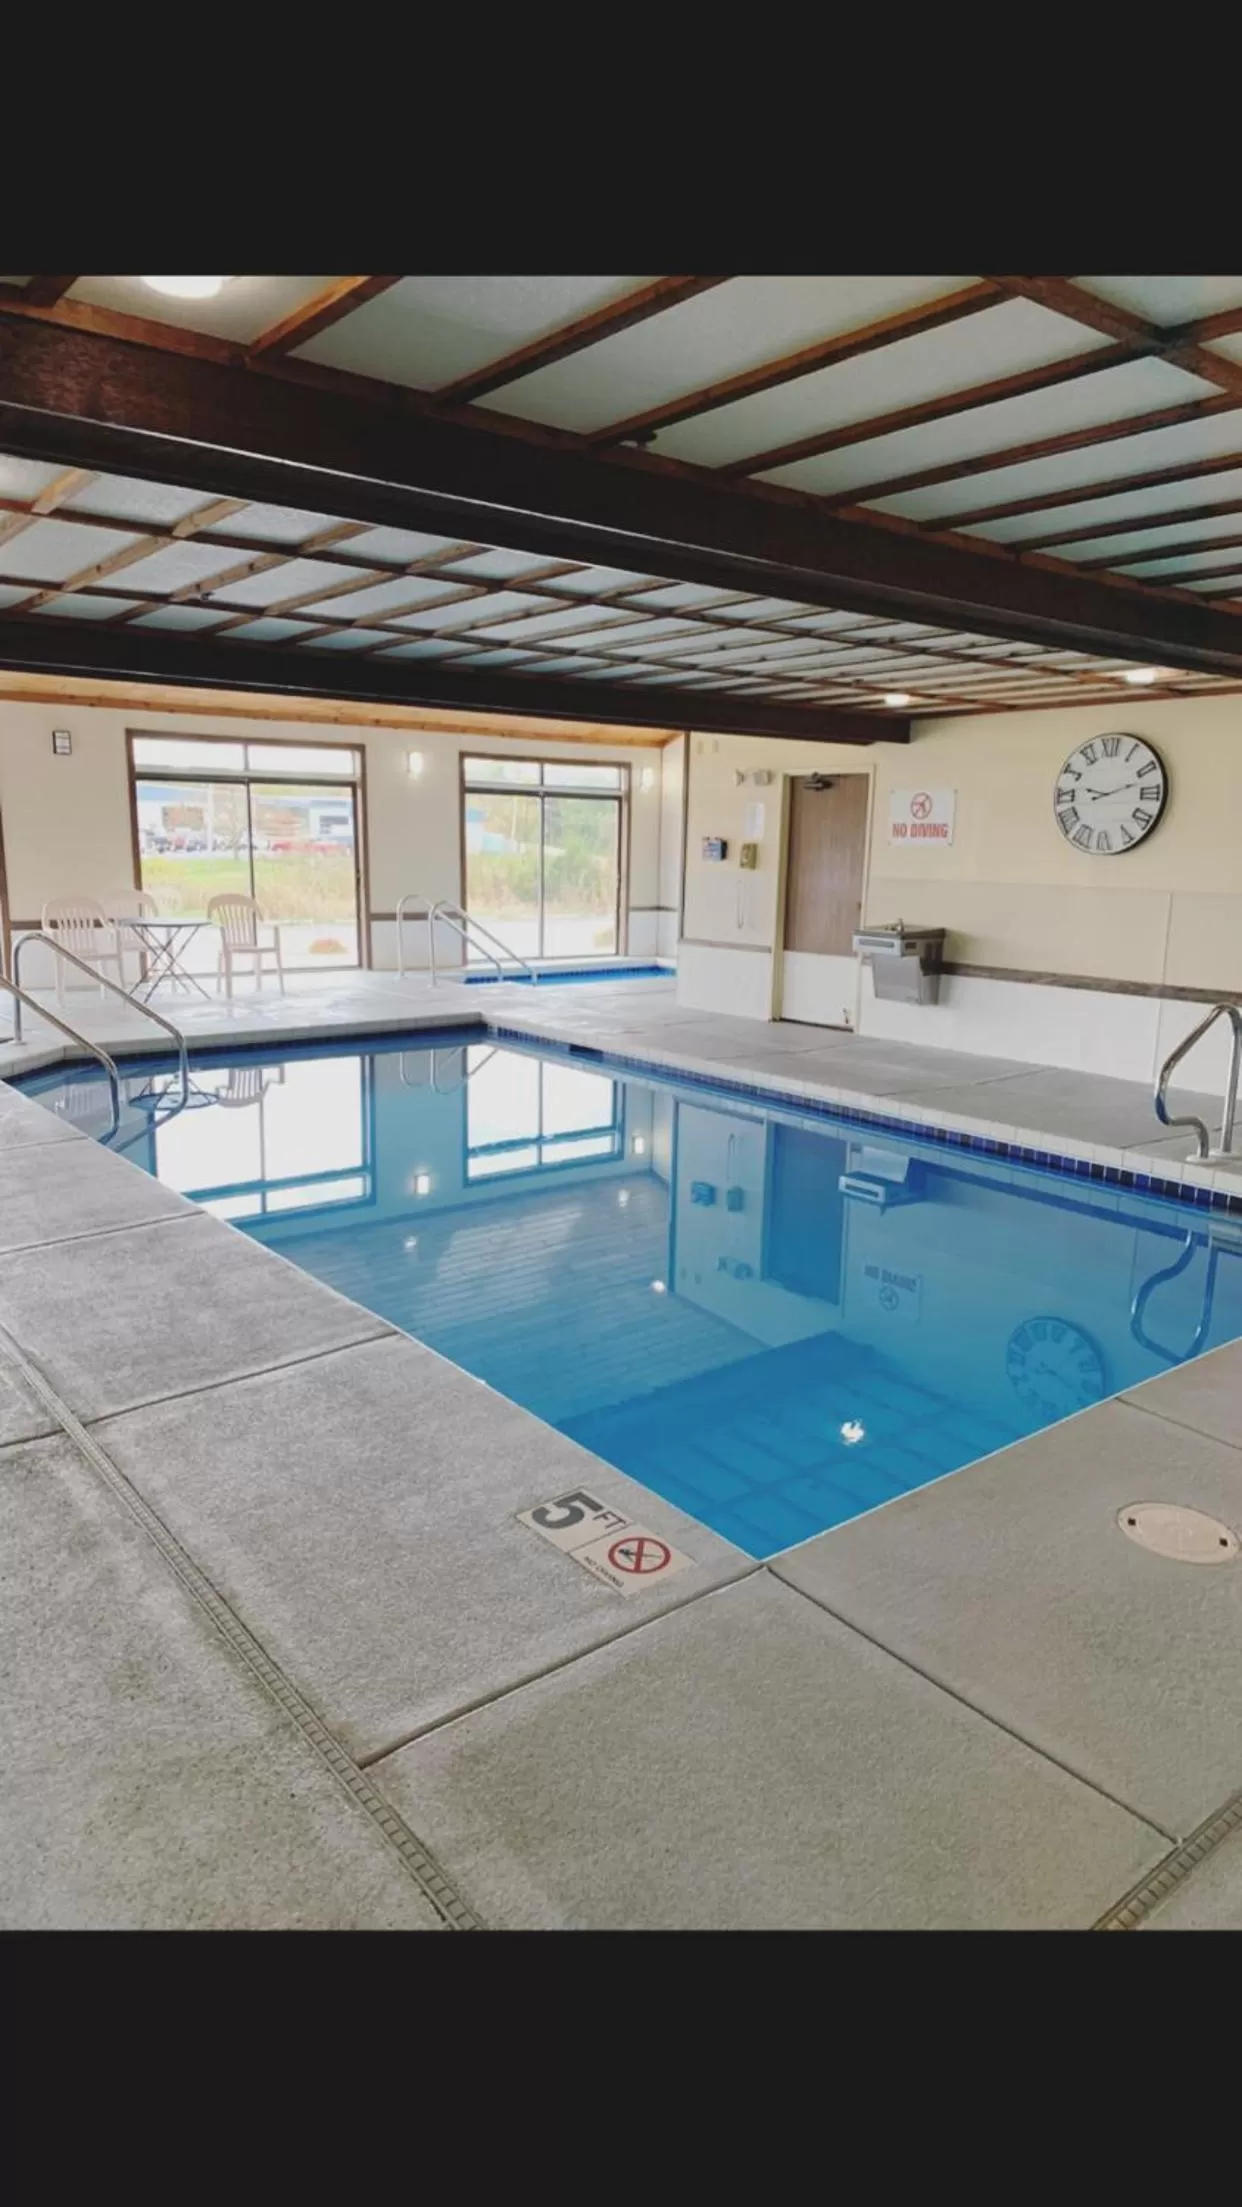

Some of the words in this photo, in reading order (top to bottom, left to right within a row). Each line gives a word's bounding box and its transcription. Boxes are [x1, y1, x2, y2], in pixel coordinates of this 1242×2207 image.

[1124, 742, 1139, 762] I
[1136, 760, 1157, 778] II
[1140, 784, 1160, 801] III
[892, 823, 908, 838] NO
[910, 823, 949, 839] DIVING
[531, 1491, 604, 1530] 5
[592, 1511, 627, 1530] FT
